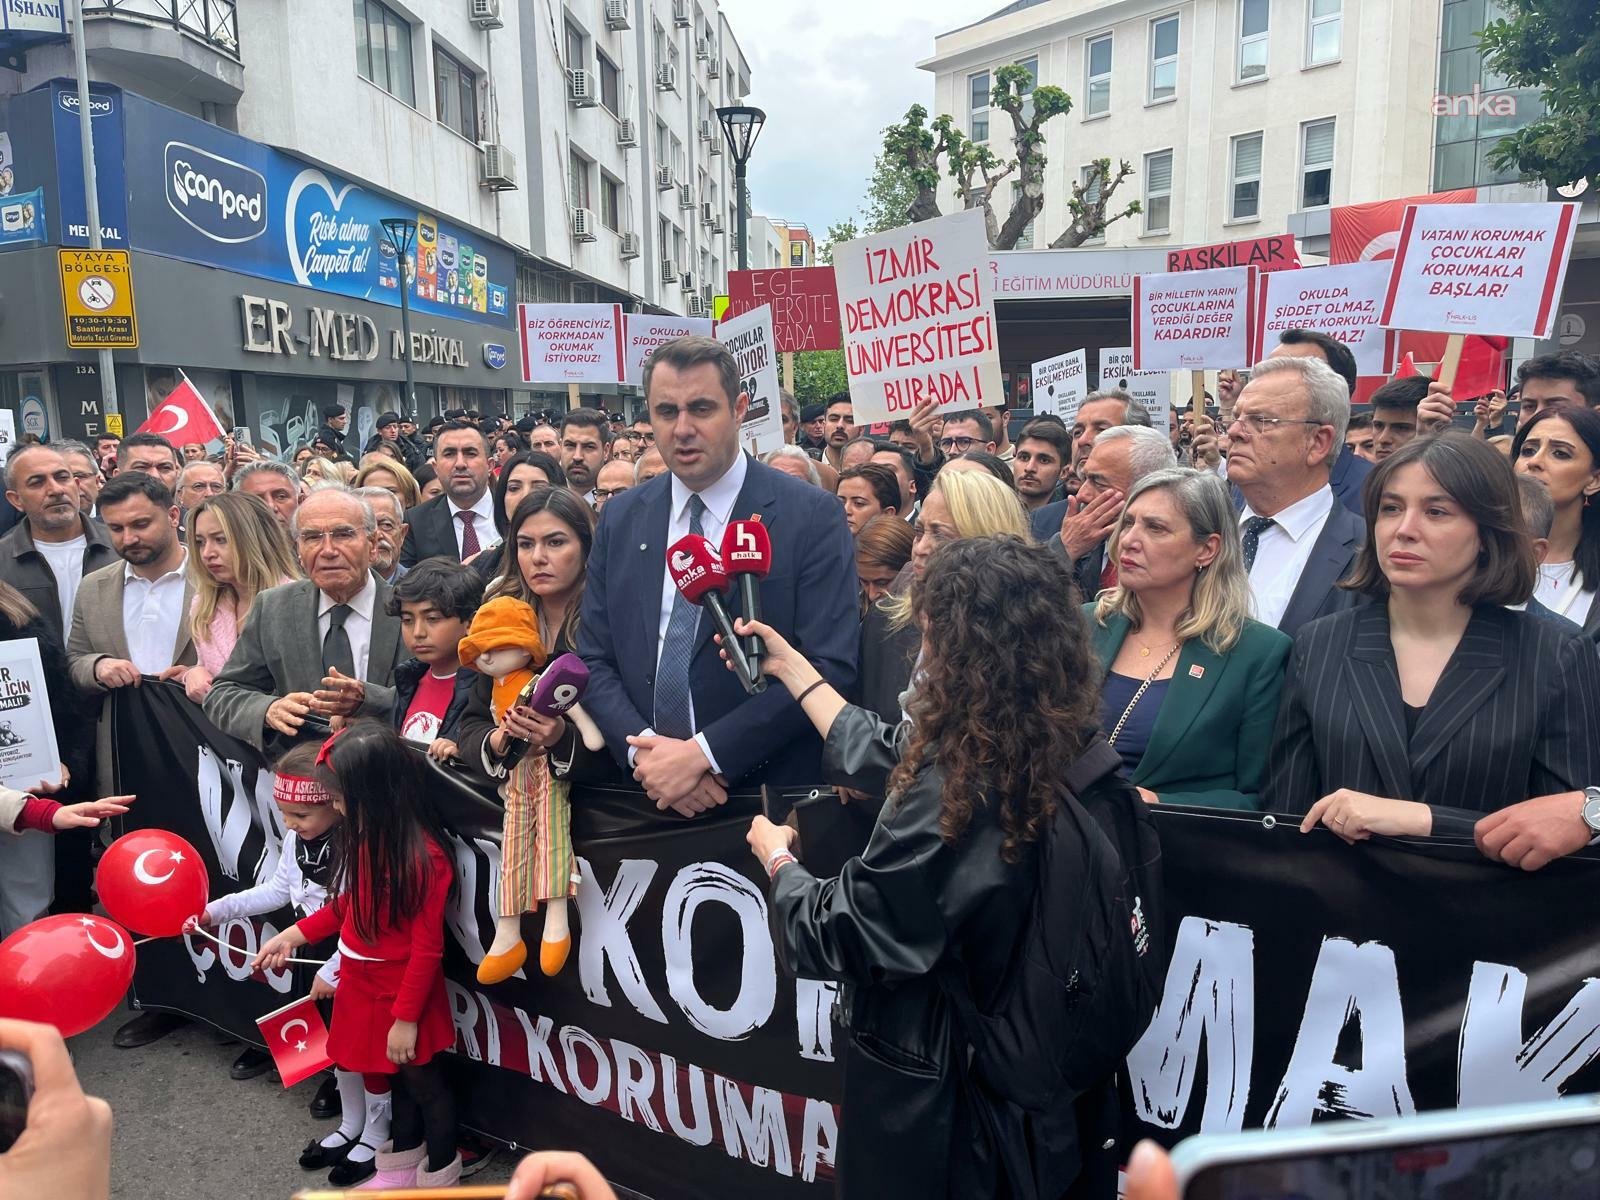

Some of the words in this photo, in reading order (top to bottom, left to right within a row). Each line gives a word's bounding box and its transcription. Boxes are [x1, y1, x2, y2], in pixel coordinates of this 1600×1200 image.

[183, 169, 262, 223] canped
[309, 211, 338, 246] Risk
[339, 216, 370, 242] alma
[1421, 229, 1469, 241] VATANI
[1470, 229, 1547, 242] KORUMAK
[73, 253, 114, 262] YAYA
[865, 235, 940, 285] İZMİR
[1431, 245, 1526, 260] ÇOCUKLARI
[64, 262, 126, 273] BÖLGESİ
[304, 246, 355, 281] Canped
[352, 247, 372, 273] al!
[1421, 263, 1524, 278] KORUMAKLA
[751, 269, 807, 297] EGE
[1002, 275, 1051, 292] EĞİTİM
[1429, 281, 1509, 298] BAŞLAR!
[845, 267, 983, 334] DEMOKRASİ
[1149, 290, 1163, 301] BİR
[1164, 288, 1205, 300] MİLLETİN
[1299, 287, 1349, 301] OKULDA
[1150, 298, 1235, 315] ÇOCUKLARINA
[1275, 303, 1322, 319] ŞİDDET
[1324, 299, 1376, 314] OLMAZ,
[73, 317, 128, 325] 10:30-19:30
[528, 318, 545, 329] BİZ
[547, 317, 613, 331] ÖĞRENCİYİZ,
[1153, 313, 1194, 326] VERDİĞİ
[1196, 311, 1233, 324] DEĞER
[1267, 318, 1317, 331] GELECEK
[538, 331, 605, 340] KORKMADAN
[649, 327, 690, 337] OKULDA
[774, 323, 817, 351] RADA
[1154, 326, 1232, 341] KADARDIR!
[549, 342, 594, 352] OKUMAK
[847, 310, 993, 376] ÜNİVERSİTESİ
[544, 353, 601, 363] İSTİYORUZ!
[1108, 354, 1119, 365] BİR
[677, 565, 706, 588] anka
[5, 680, 32, 697] İÇİN
